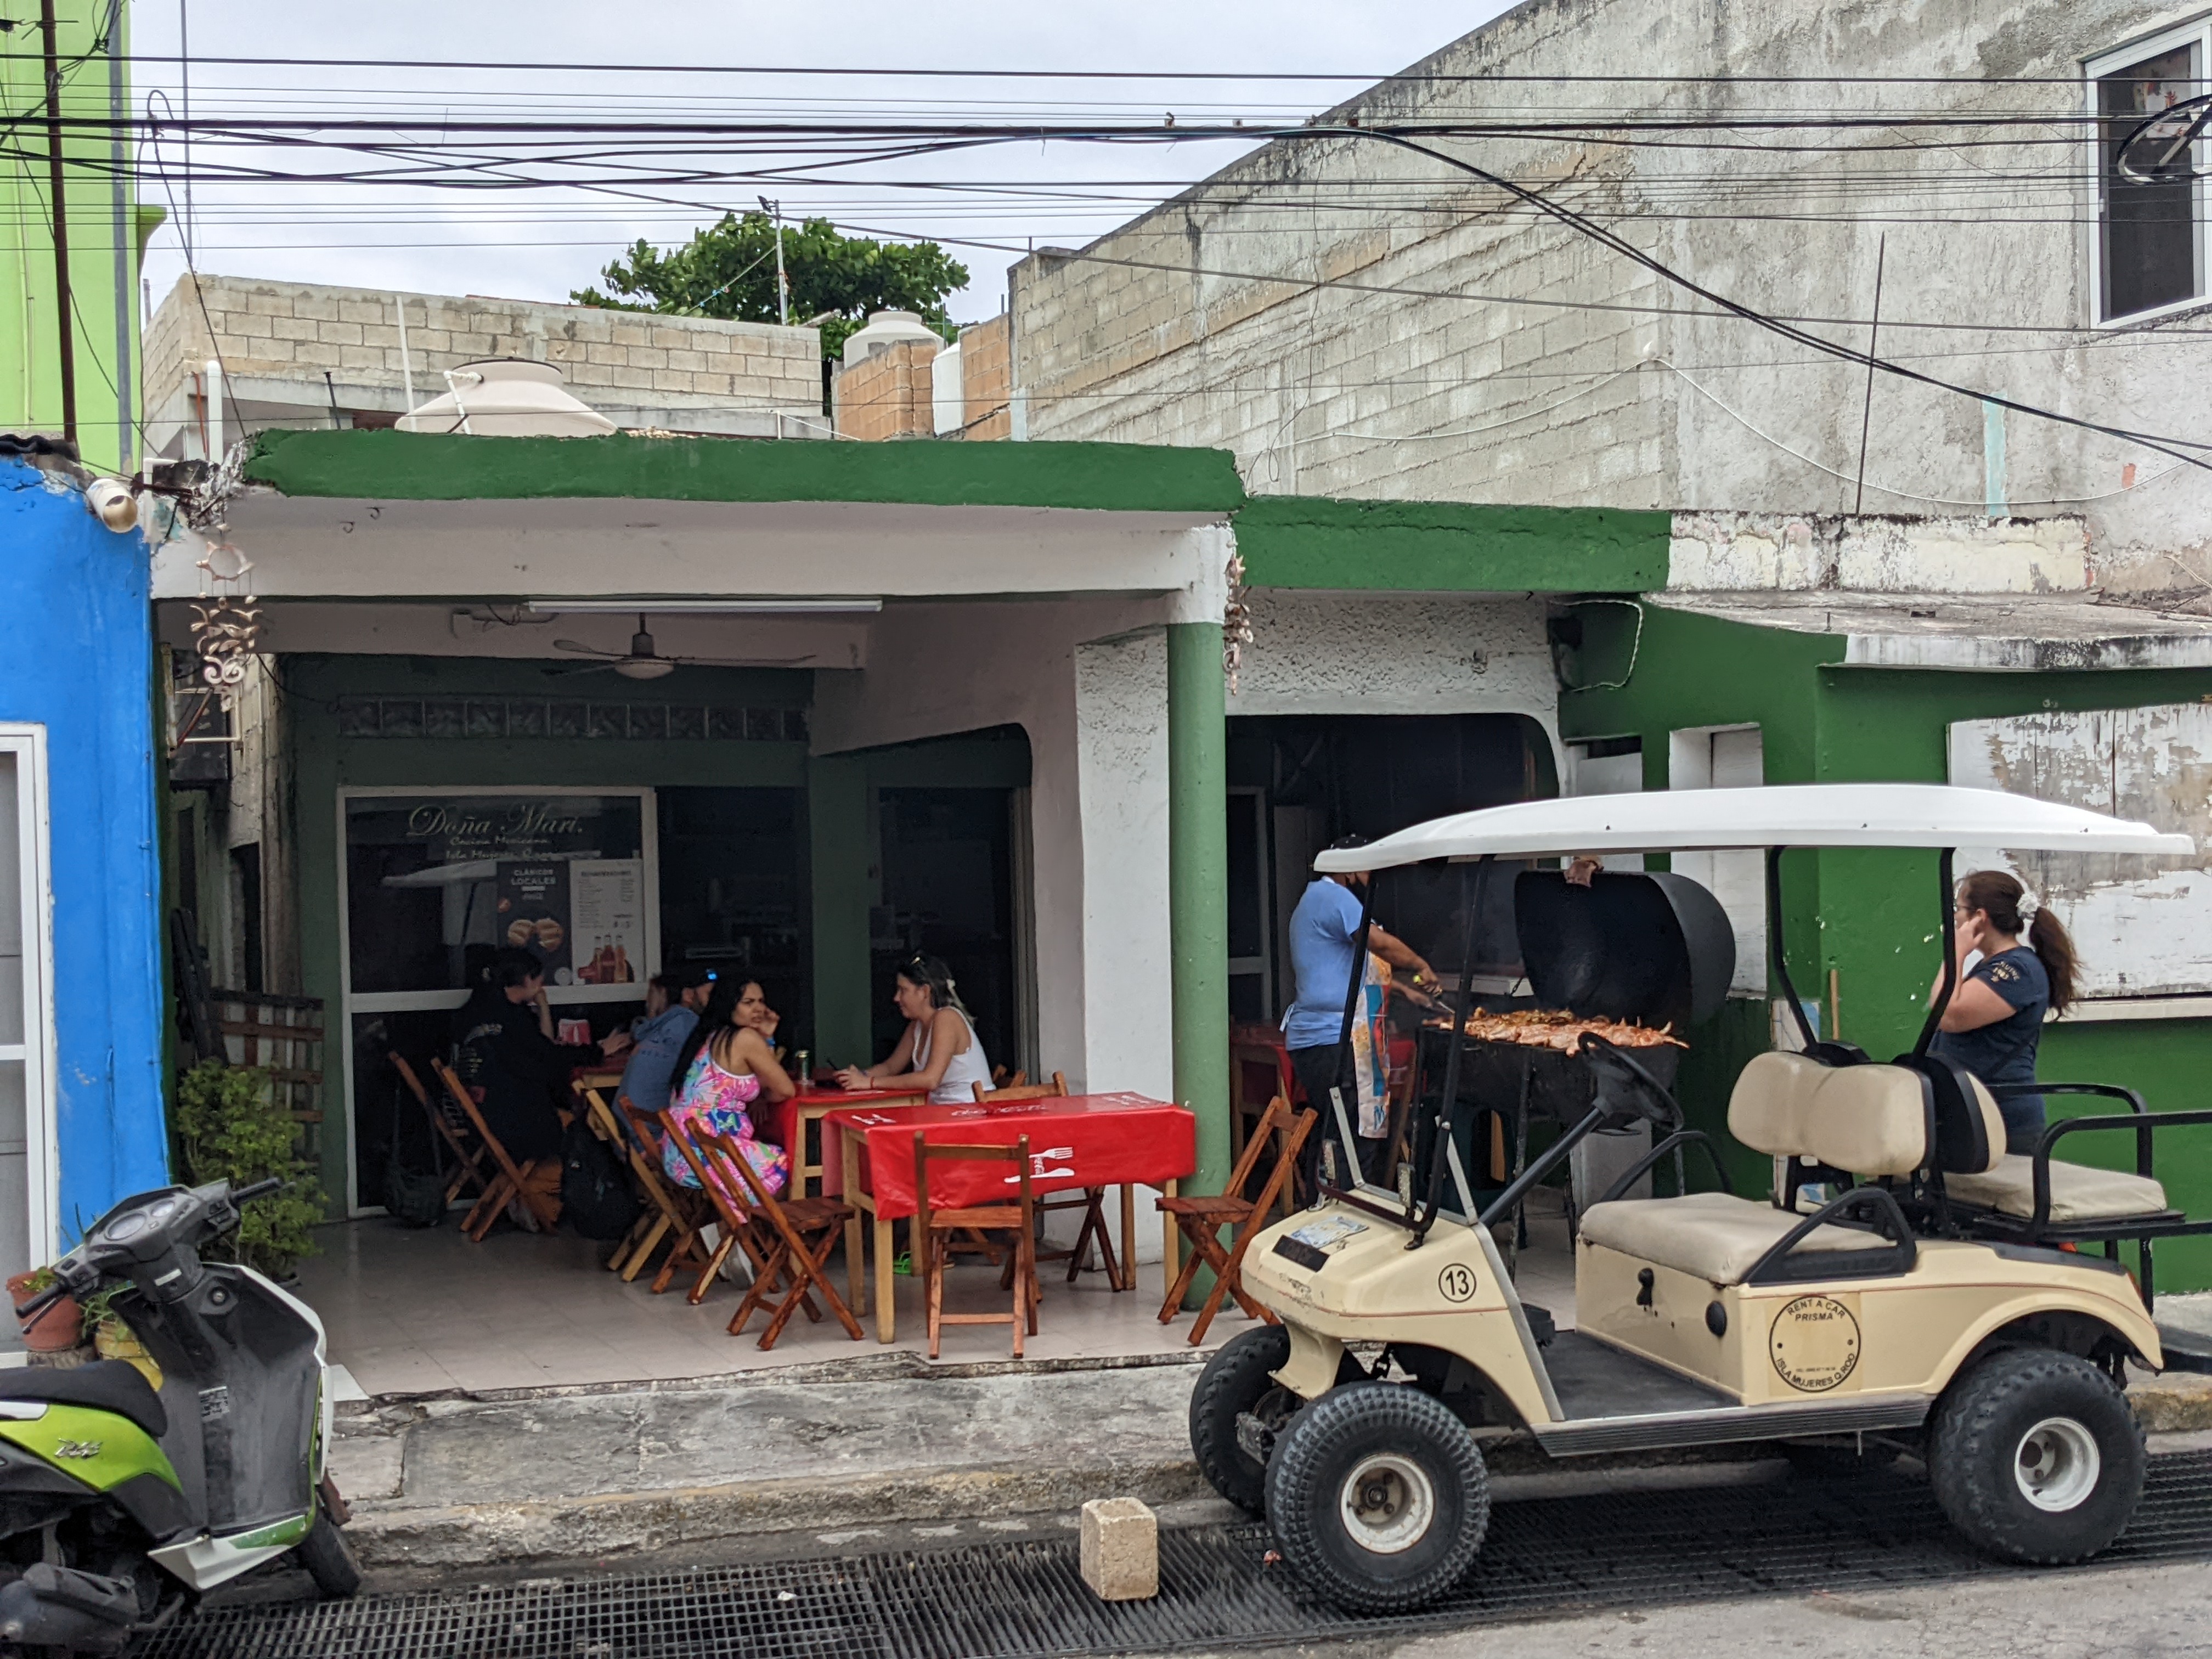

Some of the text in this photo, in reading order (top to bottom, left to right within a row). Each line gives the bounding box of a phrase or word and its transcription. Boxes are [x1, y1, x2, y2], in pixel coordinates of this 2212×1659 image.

[407, 805, 491, 836] Doña
[1445, 1269, 1469, 1296] 13
[1786, 1299, 1813, 1316] RENT
[1825, 1301, 1846, 1319] CAR
[1795, 1312, 1833, 1322] PRISMA
[1776, 1357, 1792, 1379] ISLA
[1791, 1375, 1833, 1388] MUJERES
